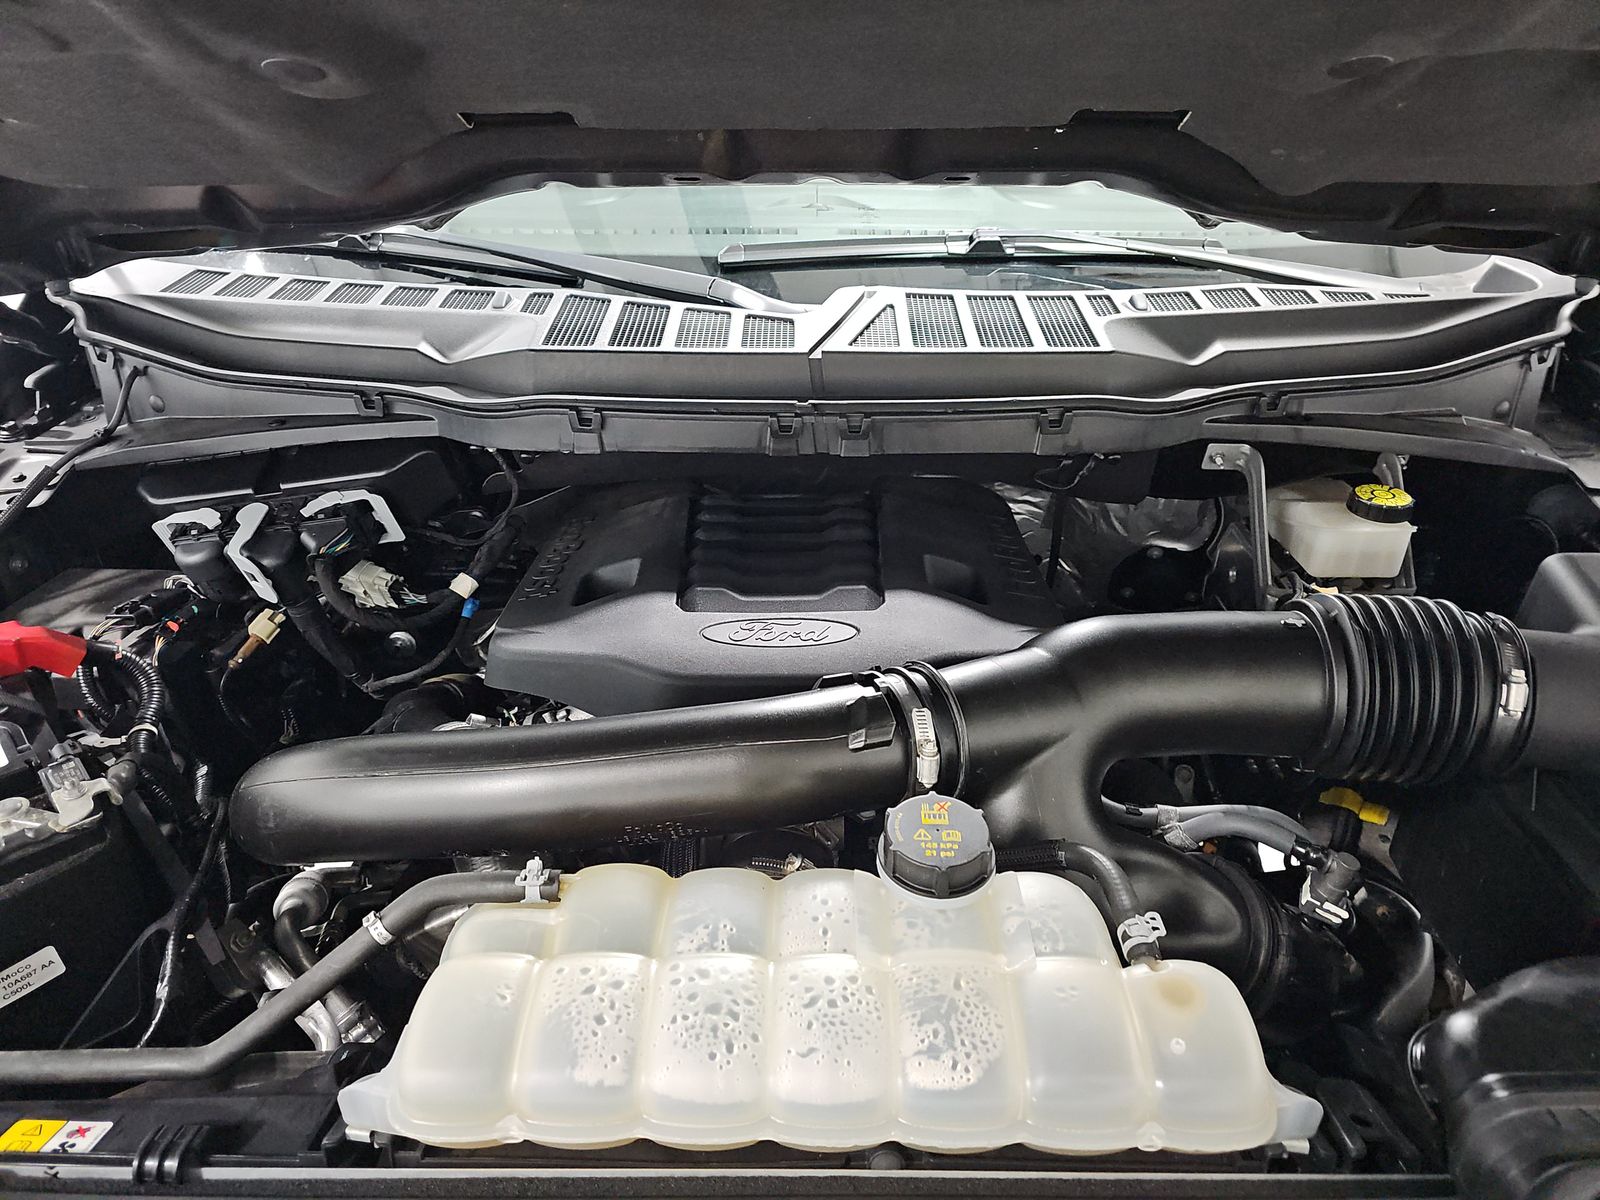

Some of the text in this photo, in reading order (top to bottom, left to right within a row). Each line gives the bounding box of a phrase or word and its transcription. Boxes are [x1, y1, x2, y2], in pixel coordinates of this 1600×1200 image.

[728, 621, 831, 642] Ford
[940, 850, 955, 858] psi
[2, 960, 55, 990] 10A687 AA
[3, 981, 35, 999] C500L
